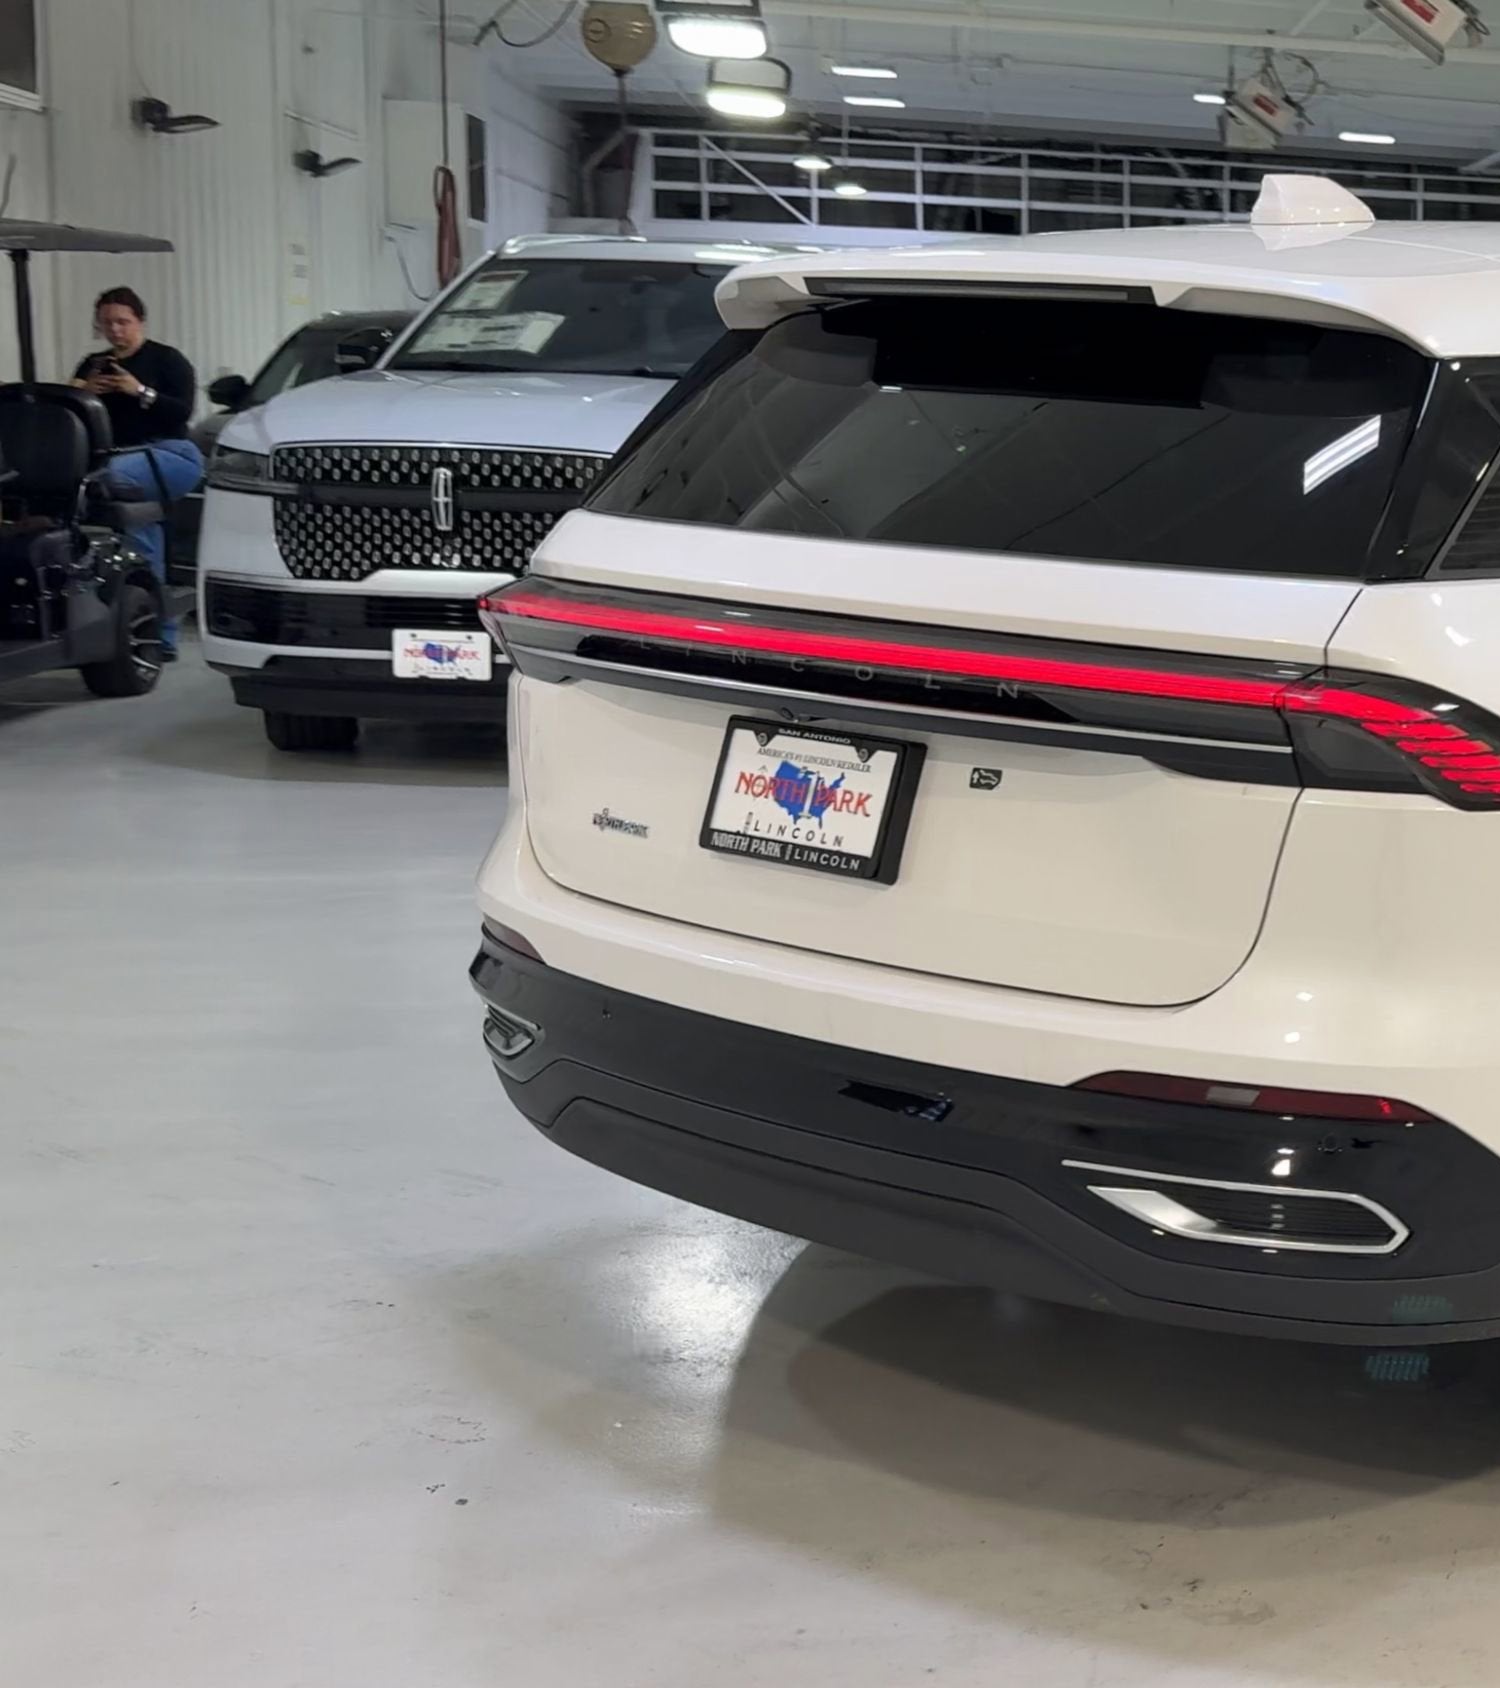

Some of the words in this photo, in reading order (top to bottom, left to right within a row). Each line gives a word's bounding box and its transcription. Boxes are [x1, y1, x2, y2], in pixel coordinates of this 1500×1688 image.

[640, 636, 1020, 699] LINCOLN
[778, 728, 801, 738] SAN
[803, 731, 851, 745] ANTONIO
[734, 771, 807, 803] NORTH
[816, 784, 873, 818] PARK
[711, 831, 750, 852] NORTH
[750, 839, 782, 858] PARK
[794, 848, 860, 871] LINCOLN
[754, 820, 845, 847] LINCOLN
